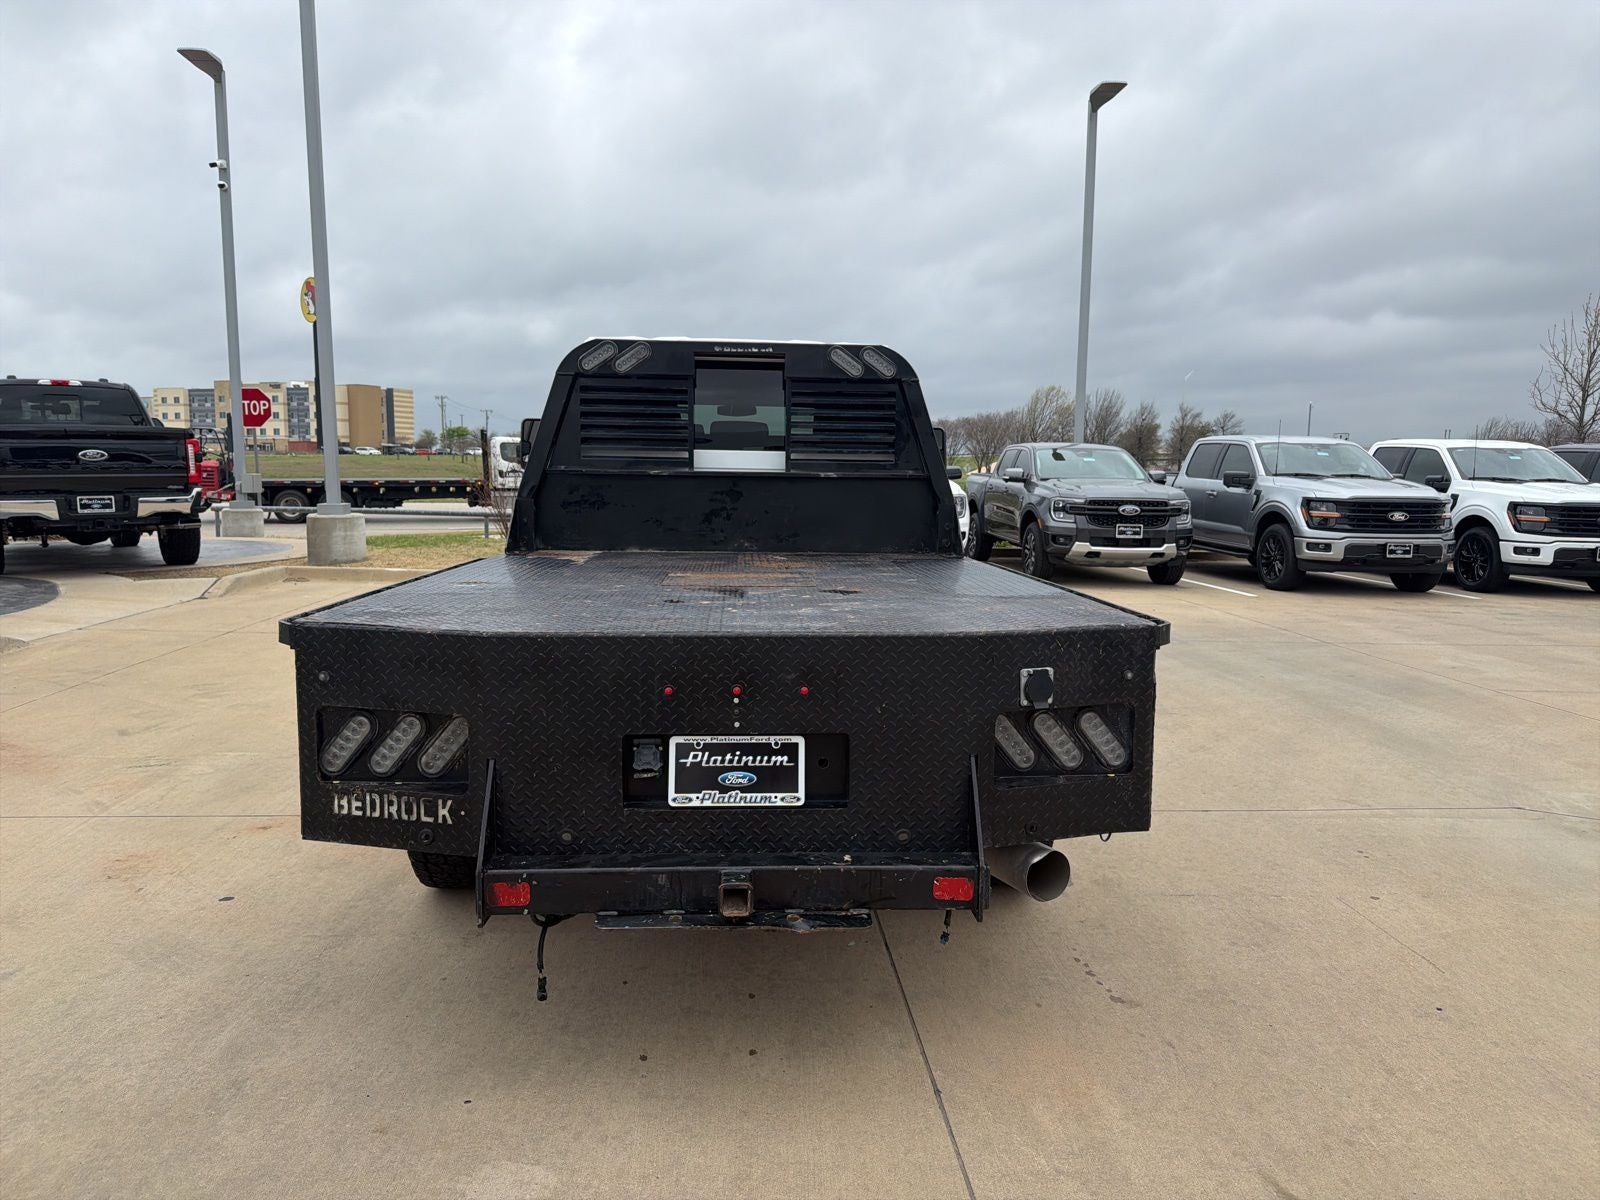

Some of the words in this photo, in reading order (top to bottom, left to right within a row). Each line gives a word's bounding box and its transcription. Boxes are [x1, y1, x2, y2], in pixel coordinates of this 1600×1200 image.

[242, 400, 269, 415] TOP
[678, 751, 795, 767] Platinum
[725, 774, 750, 785] Ford
[699, 791, 778, 805] Platinum
[333, 792, 453, 825] BEDROCK
